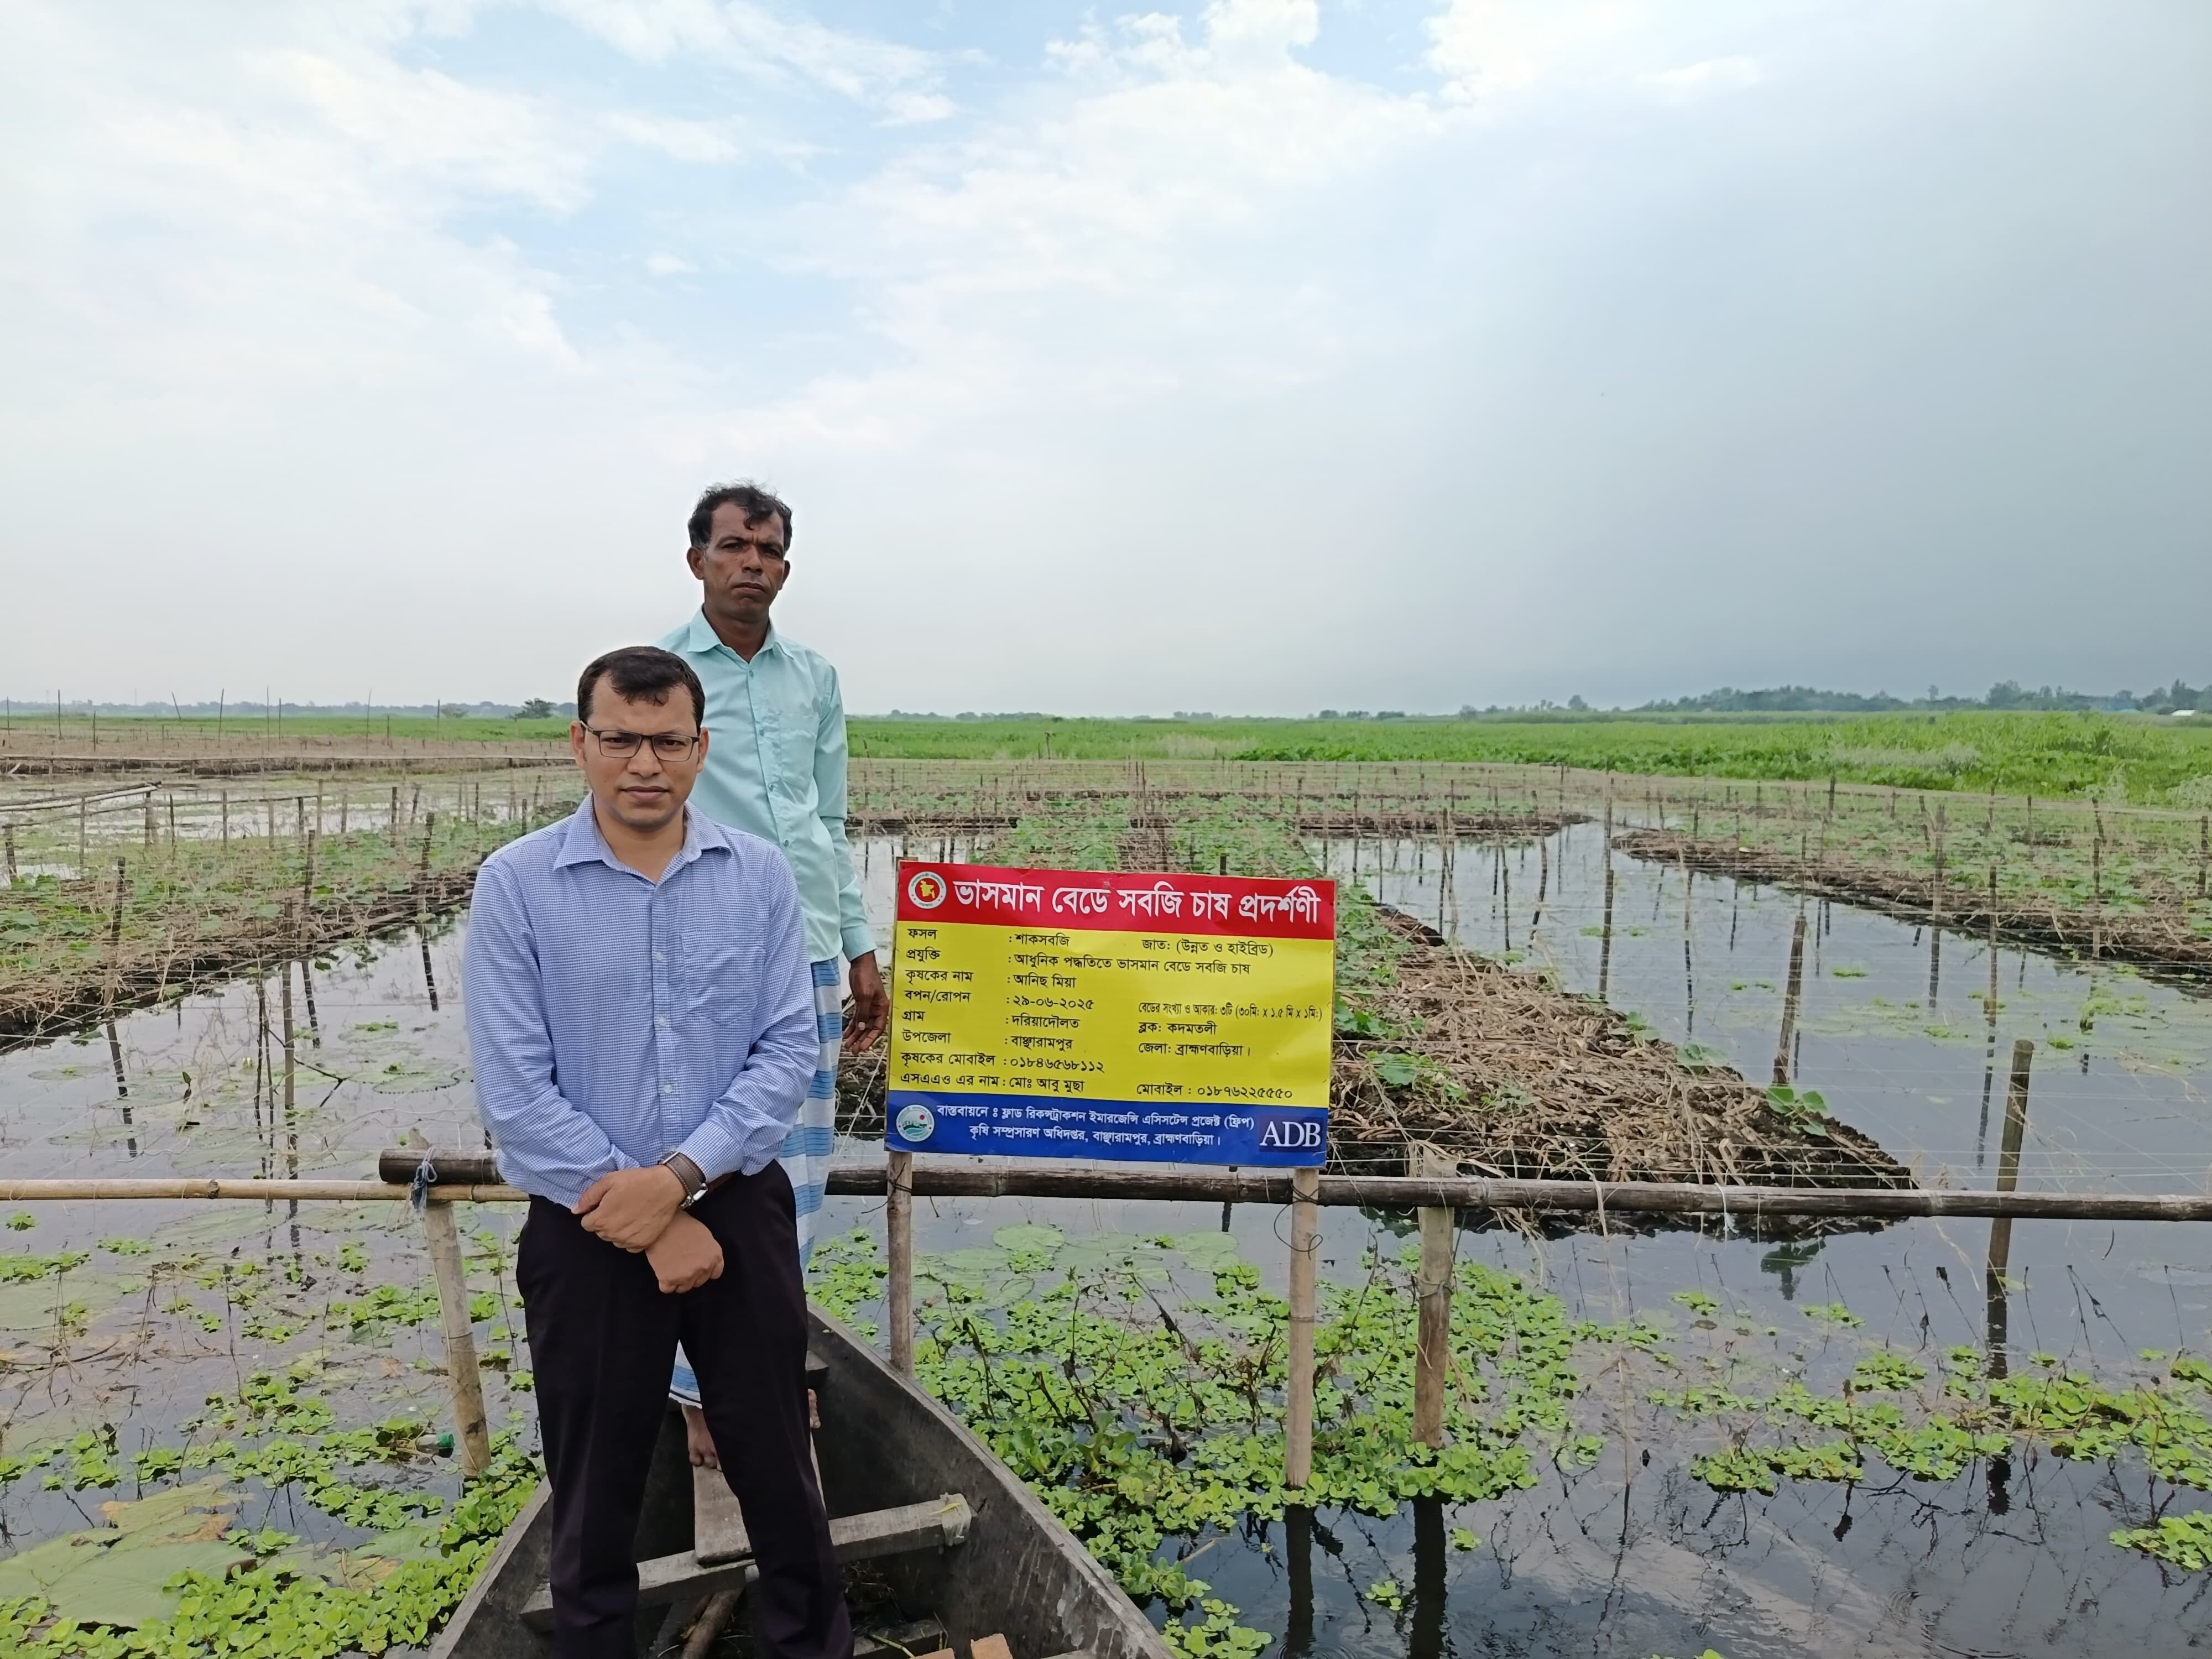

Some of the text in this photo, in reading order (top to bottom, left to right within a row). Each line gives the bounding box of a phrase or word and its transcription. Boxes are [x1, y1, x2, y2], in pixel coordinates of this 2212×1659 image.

[952, 878, 1045, 913] ভাসমান
[1051, 885, 1112, 916] বেডে
[1118, 881, 1185, 919] সবজি
[1190, 890, 1232, 921] চাষ
[906, 928, 938, 940] ফসল
[1015, 932, 1071, 947] শাকসবজি
[1176, 938, 1208, 955] (উন্নত
[1213, 945, 1222, 953] ও
[1227, 941, 1274, 958] হাইব্রিড)
[906, 946, 941, 962] প্রযুক্তি
[1014, 953, 1058, 968] আধুনিক
[1063, 954, 1113, 969] পদ্ধতিতে
[1117, 959, 1160, 972] ভাসমান
[1164, 961, 1192, 973] বেডে
[1196, 959, 1228, 974] সবজি
[1232, 963, 1251, 975] চাষ
[905, 969, 949, 985] কৃষকের
[952, 971, 974, 983] নাম
[1013, 974, 1048, 988] আনিছ
[1052, 973, 1076, 989] মিয়া
[904, 989, 972, 1004] বপন/রোপন
[1013, 995, 1095, 1010] ২৯-০৬-২০২৫
[1138, 1002, 1160, 1014] বেডের
[1162, 1003, 1182, 1015] সংখ্যা
[1185, 1004, 1191, 1014] ও
[1220, 1001, 1233, 1016] ৩টি
[1286, 1004, 1294, 1018] মি
[902, 1010, 926, 1022] গ্রাম
[1011, 1012, 1081, 1029] দরিয়াদৌলত
[1166, 1020, 1218, 1036] কদমতলী
[901, 1027, 951, 1044] উপজেলা
[1175, 1041, 1244, 1058] ব্রাহ্মণবাড়িয়া
[900, 1052, 944, 1068] কৃষকের
[948, 1052, 996, 1066] মোবাইল
[1010, 1056, 1105, 1074] ০১৮৪৬৫৬৮১১২
[900, 1073, 951, 1085] এসএএও
[956, 1075, 974, 1086] এর
[978, 1076, 999, 1087] নাম
[1036, 1078, 1061, 1093] আবু
[1063, 1079, 1085, 1094] মুছা
[1136, 1082, 1184, 1096] মোবাইল
[1197, 1086, 1293, 1099] ০১৮৭৬২২৫৫৫০
[936, 1104, 989, 1118] বাস্তবায়নে
[1001, 1108, 1024, 1120] ফ্লাড
[968, 1124, 989, 1140] কৃষি
[993, 1128, 1040, 1141] সম্প্রসারণ
[1152, 1131, 1214, 1147] ব্রাহ্মণবাড়িয়া
[1259, 1120, 1322, 1147] ADB
